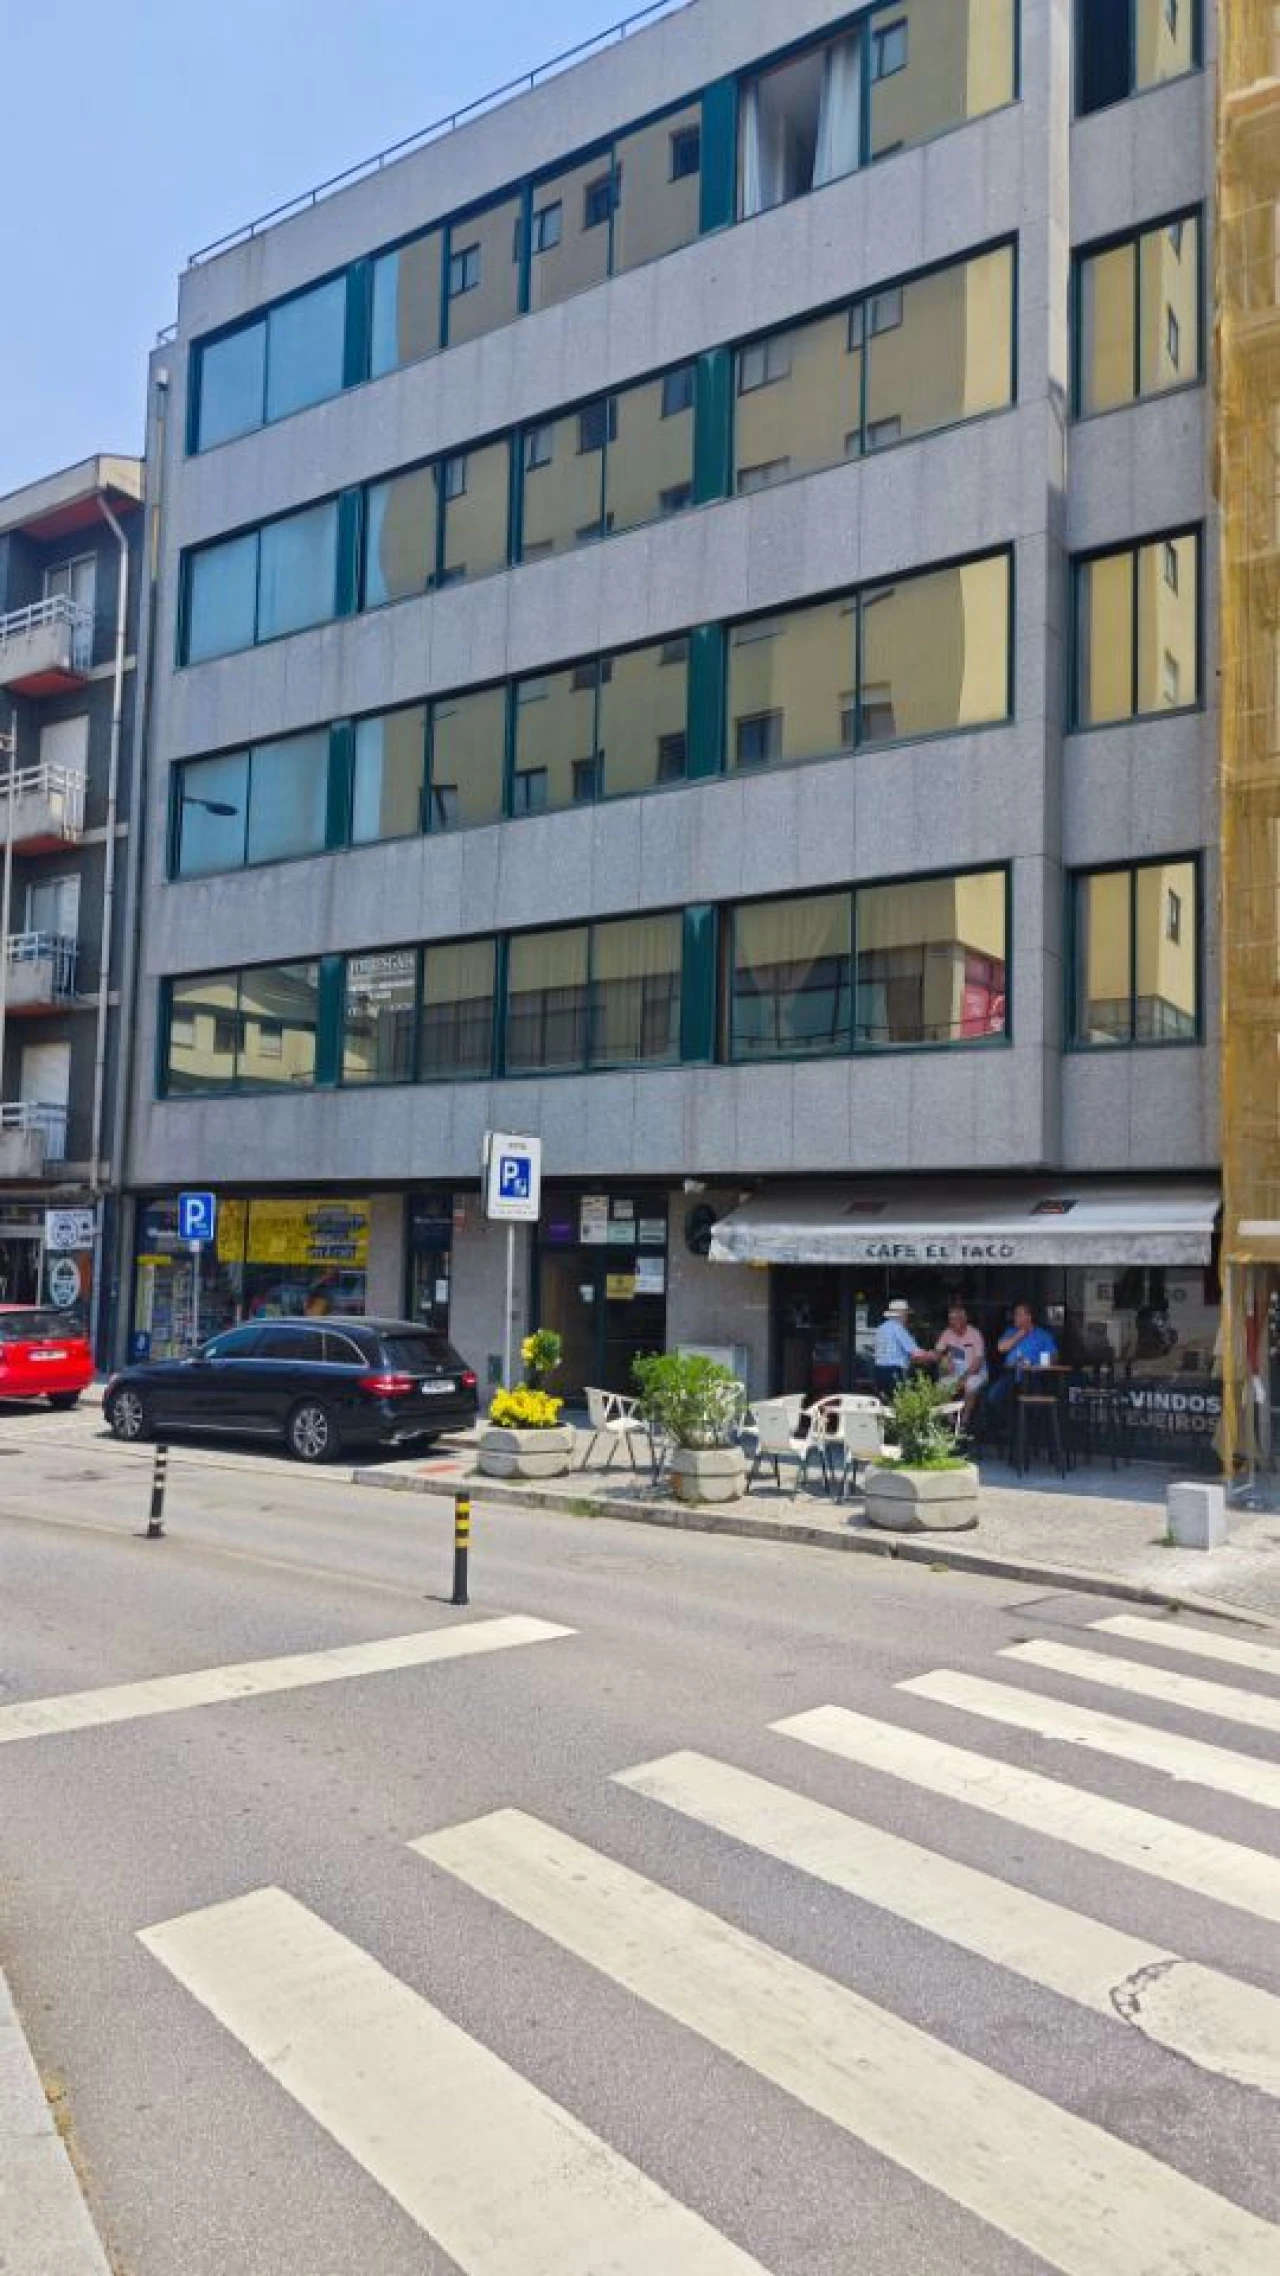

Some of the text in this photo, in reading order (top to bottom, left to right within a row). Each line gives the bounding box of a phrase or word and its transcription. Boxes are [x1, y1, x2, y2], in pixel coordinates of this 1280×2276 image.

[503, 1160, 519, 1189] P
[186, 1199, 205, 1236] P
[926, 1244, 949, 1258] EL
